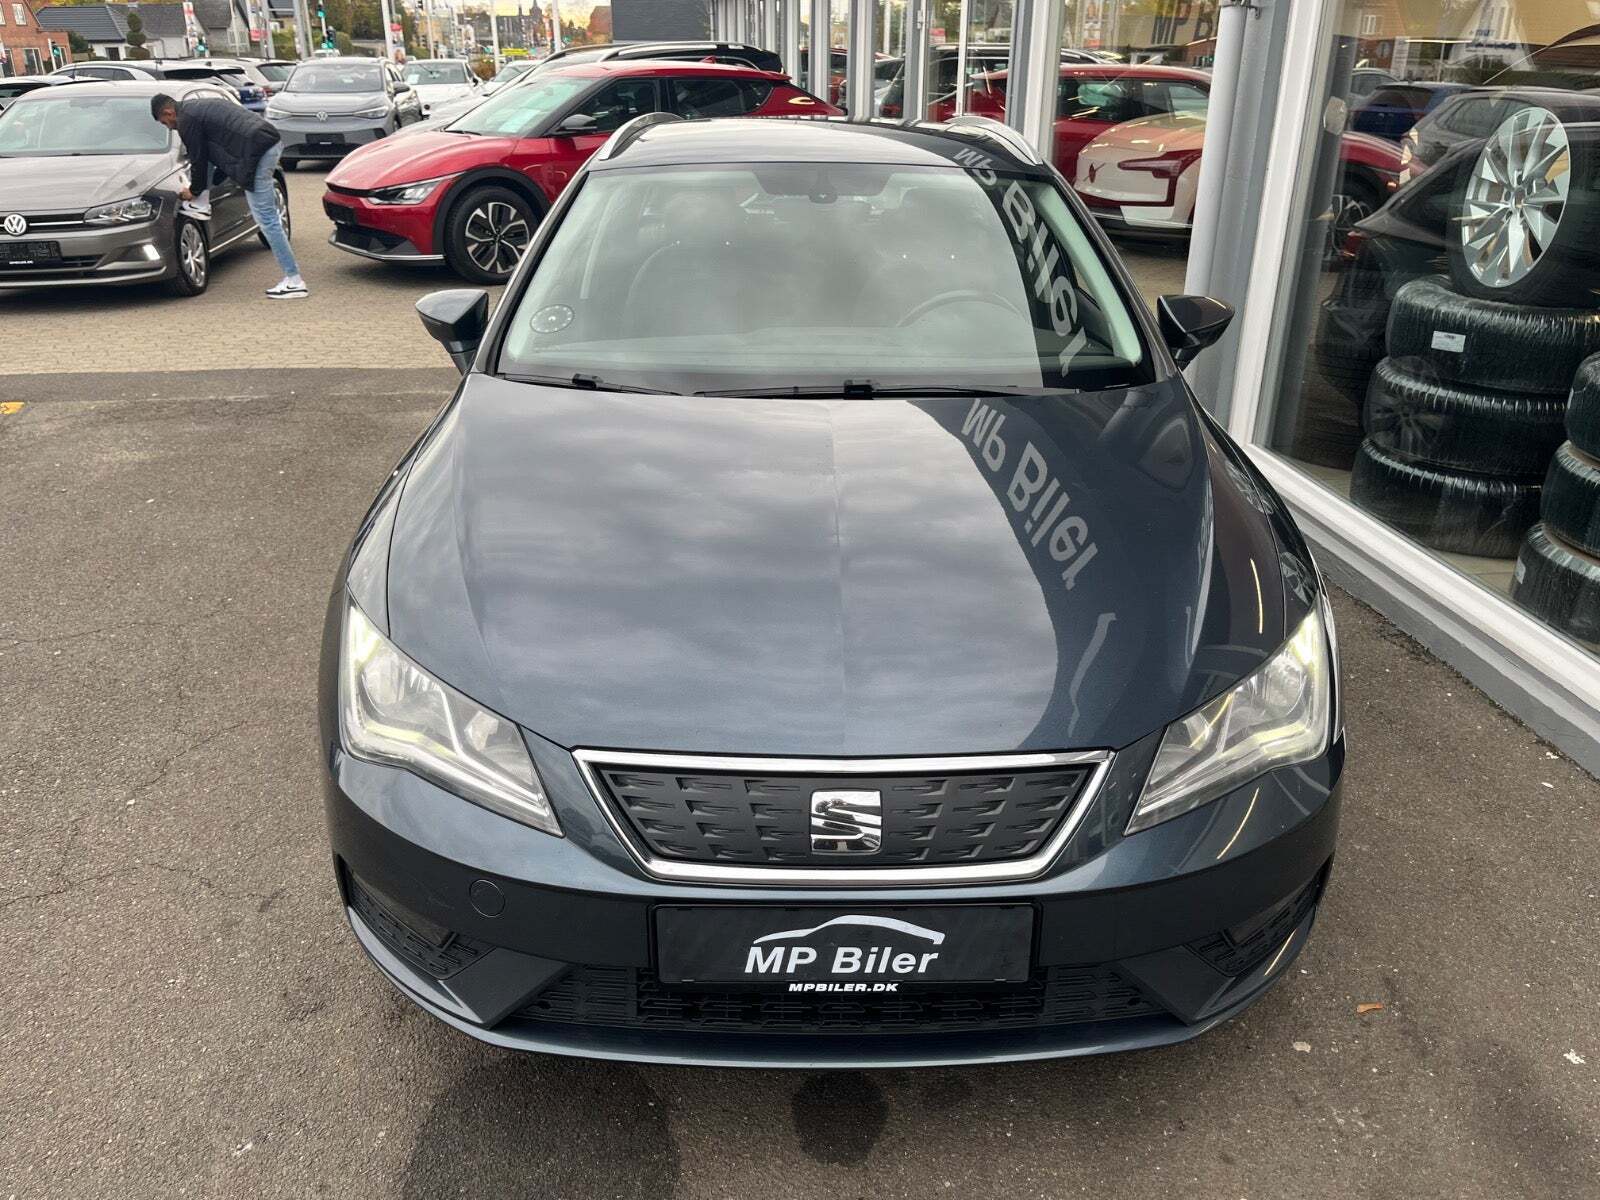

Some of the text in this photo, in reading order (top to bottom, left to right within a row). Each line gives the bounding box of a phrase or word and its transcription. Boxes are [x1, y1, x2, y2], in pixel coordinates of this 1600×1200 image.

[744, 946, 939, 974] MP Biler
[788, 983, 899, 992] MPBILER.DK
